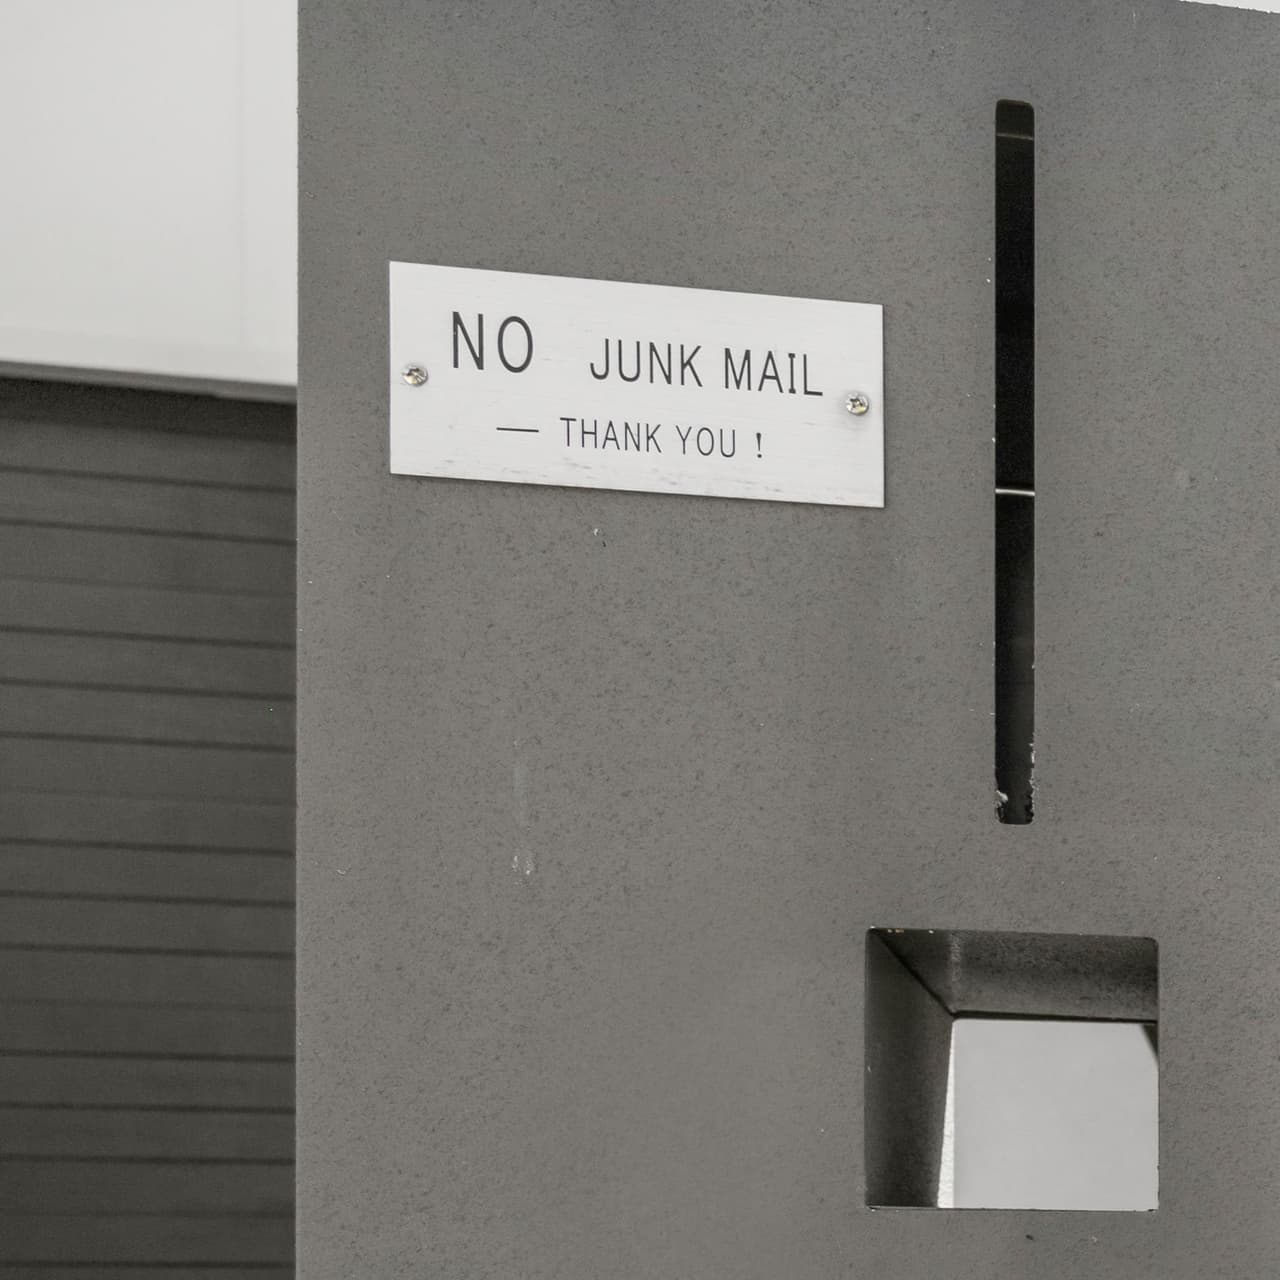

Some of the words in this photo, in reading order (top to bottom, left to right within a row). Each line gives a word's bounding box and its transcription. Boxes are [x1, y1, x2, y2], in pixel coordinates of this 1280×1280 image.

[451, 310, 535, 375] NO
[588, 337, 704, 388] JUNK
[723, 346, 825, 398] MAIL
[558, 415, 663, 455] THANK
[674, 424, 737, 459] YOU
